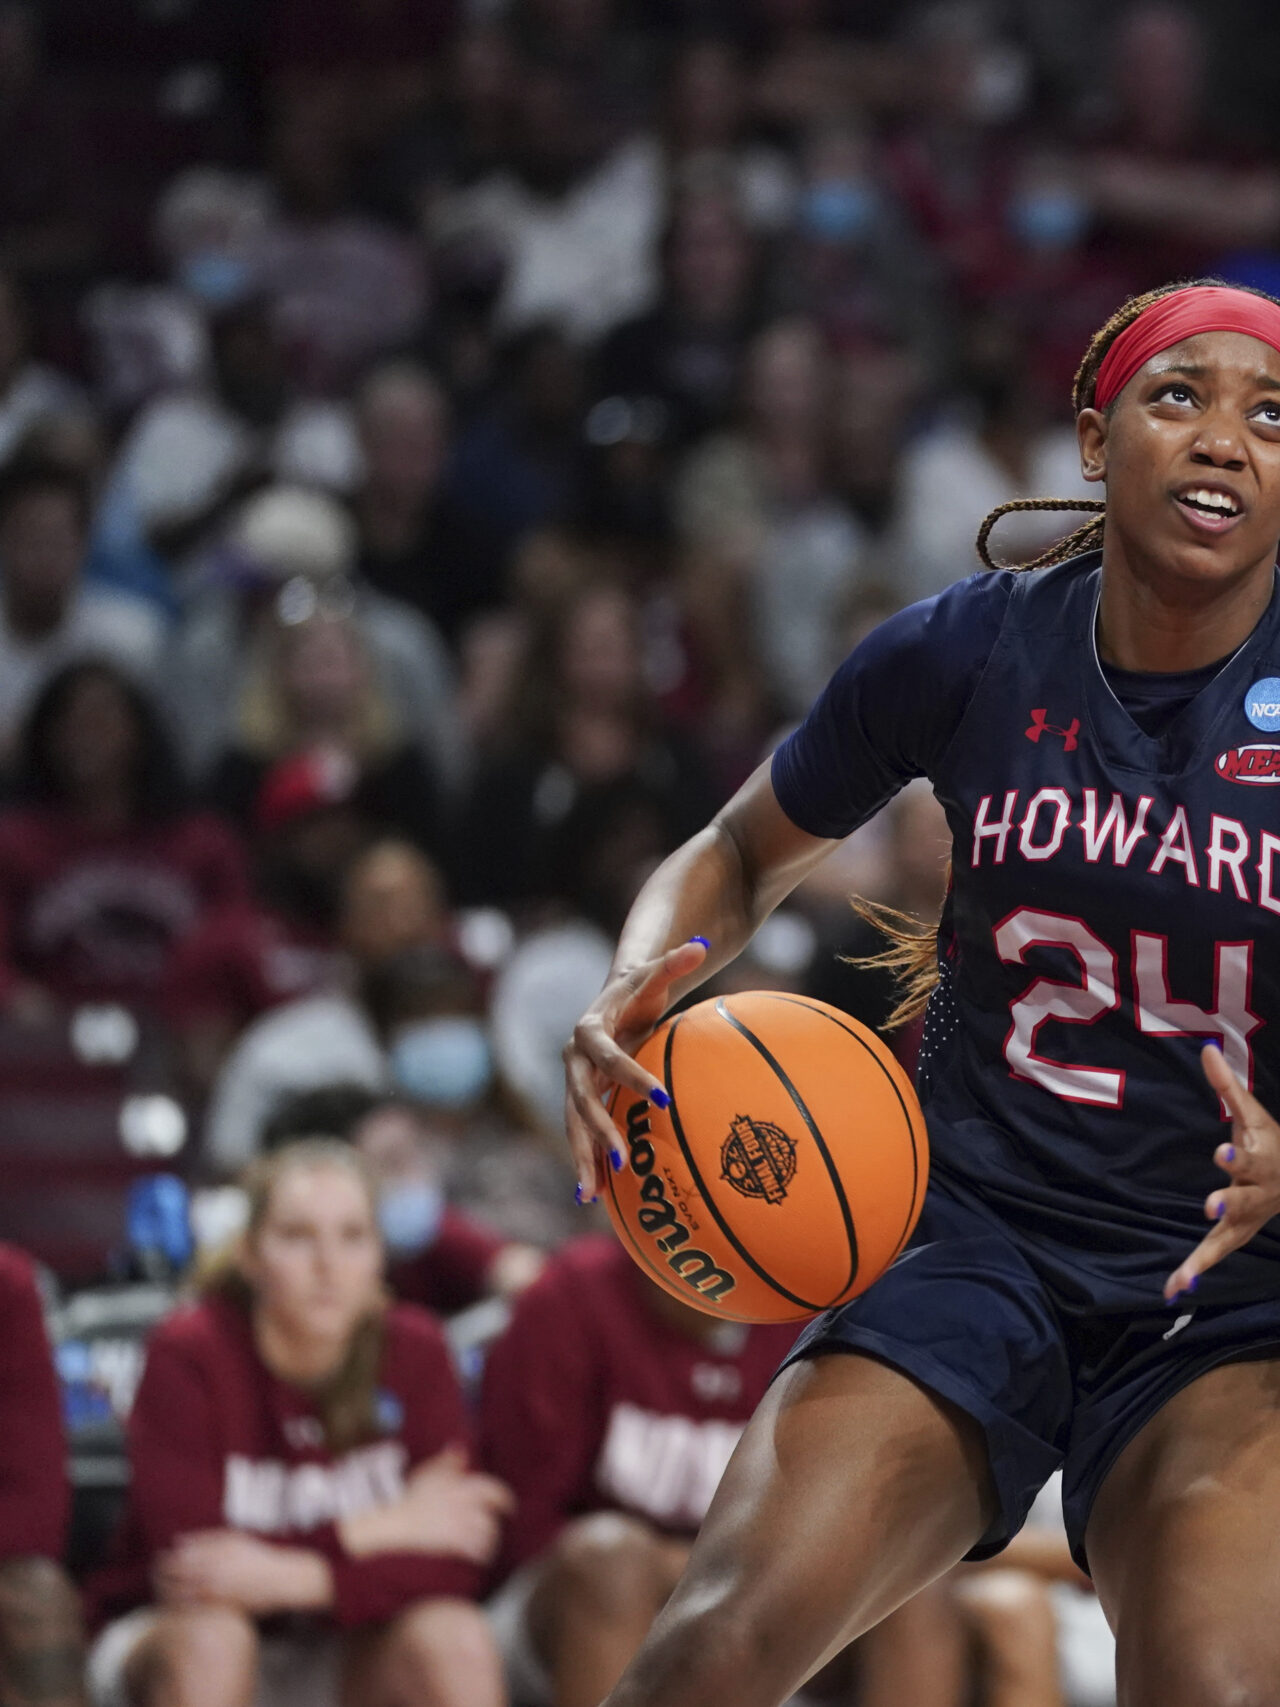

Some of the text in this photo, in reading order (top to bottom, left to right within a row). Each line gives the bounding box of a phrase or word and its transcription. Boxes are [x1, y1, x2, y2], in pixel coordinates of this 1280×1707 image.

[992, 904, 1268, 1123] 24
[625, 1099, 737, 1304] Wilson
[735, 1120, 764, 1160] FOUR
[753, 1158, 785, 1200] FINAL
